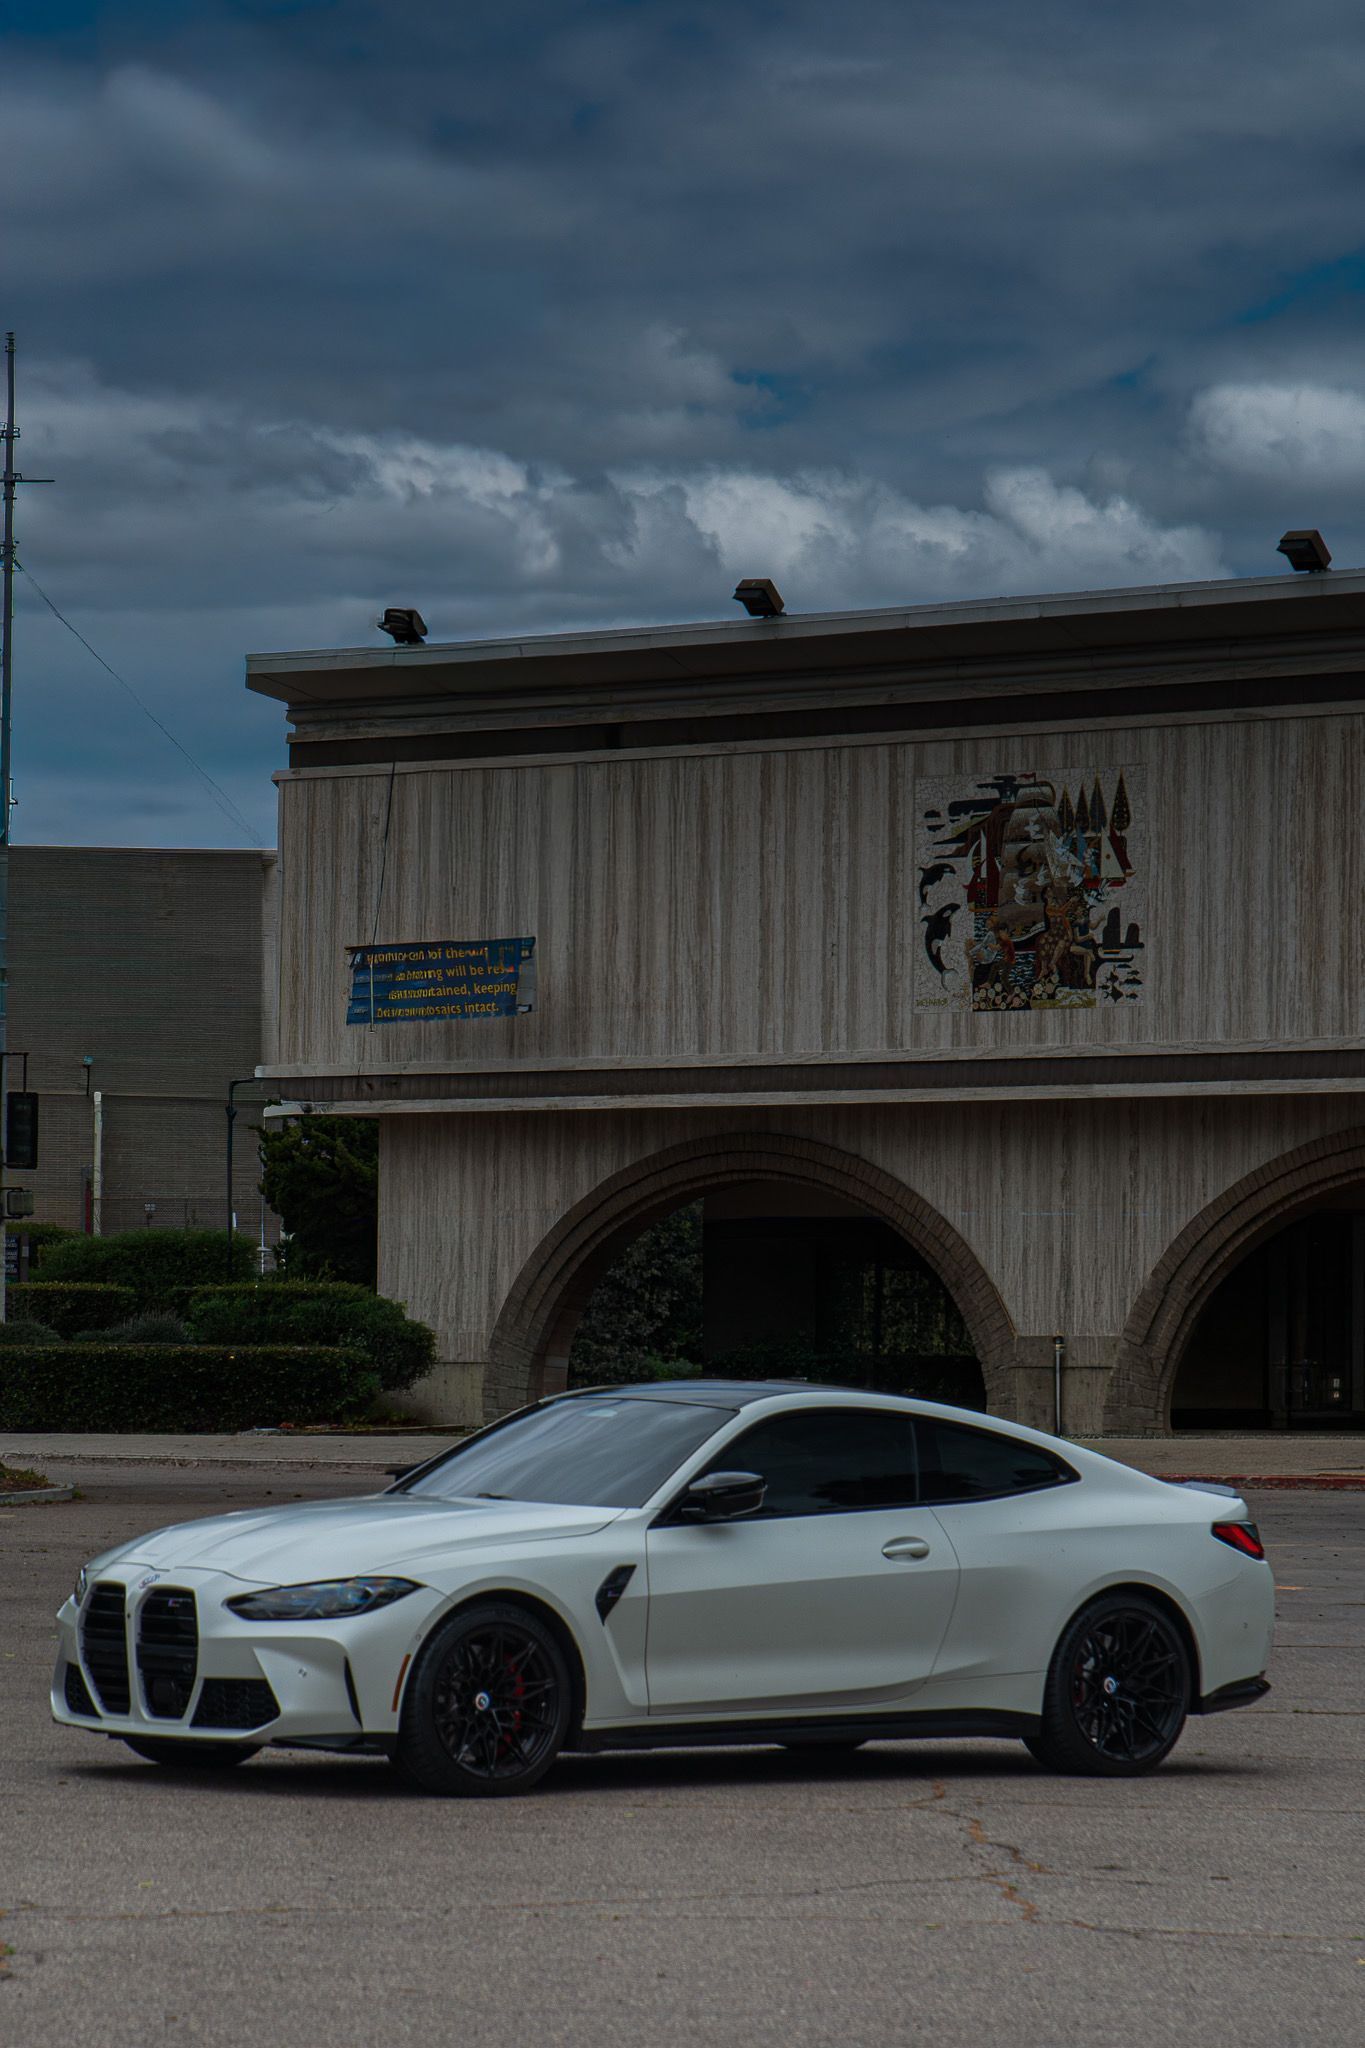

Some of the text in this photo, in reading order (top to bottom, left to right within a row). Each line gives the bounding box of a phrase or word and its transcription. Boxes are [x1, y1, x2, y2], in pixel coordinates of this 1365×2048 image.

[446, 947, 465, 959] the
[445, 963, 466, 977] will
[470, 963, 485, 976] be
[474, 982, 517, 997] keeping
[464, 1002, 499, 1014] intact.
